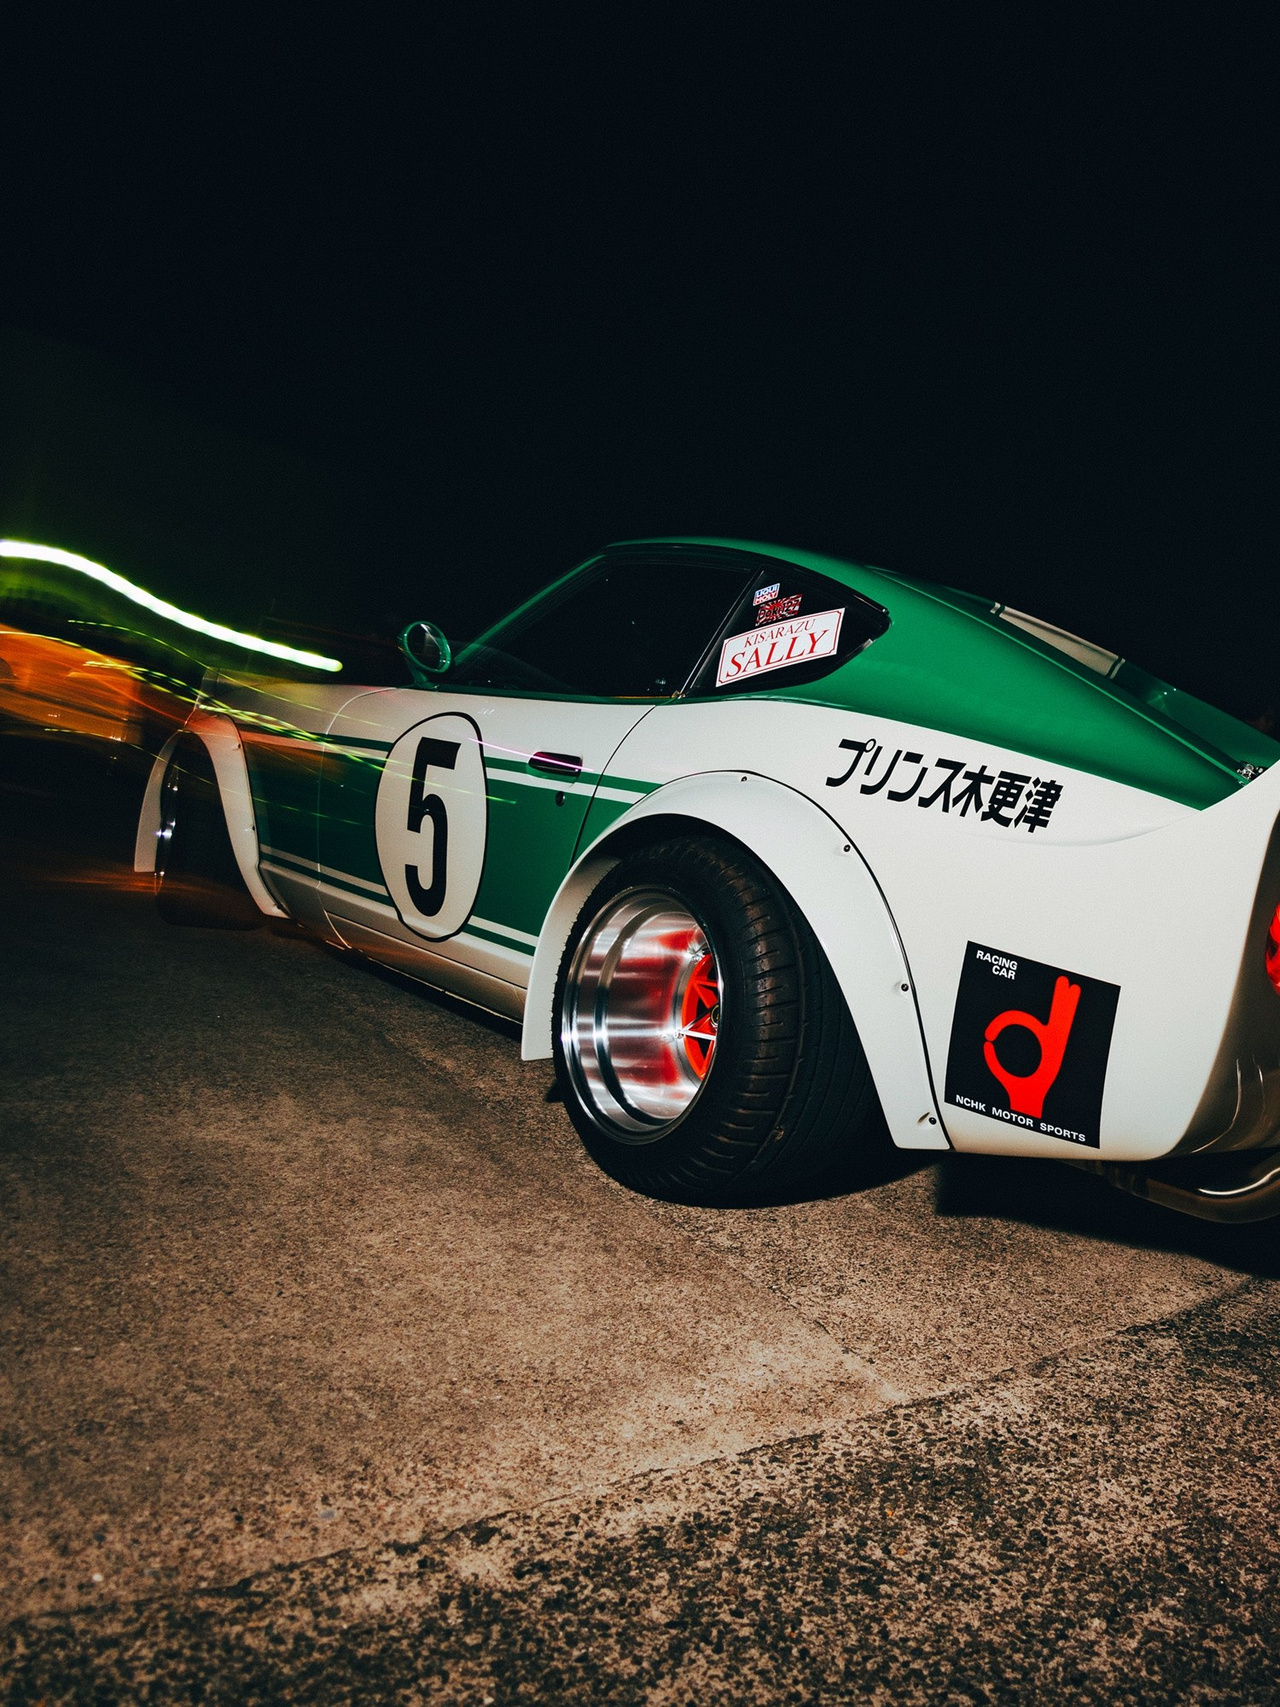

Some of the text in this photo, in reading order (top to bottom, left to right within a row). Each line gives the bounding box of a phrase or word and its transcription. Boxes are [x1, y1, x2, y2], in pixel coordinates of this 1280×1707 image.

[726, 629, 829, 678] SALLY
[744, 619, 816, 647] KISARAZU
[825, 738, 1064, 834] プリンス木更津
[405, 737, 461, 916] 5
[976, 949, 1018, 971] RACING
[992, 965, 1016, 980] CAR
[955, 1094, 1086, 1142] NCHK MOTOR SPORTS
